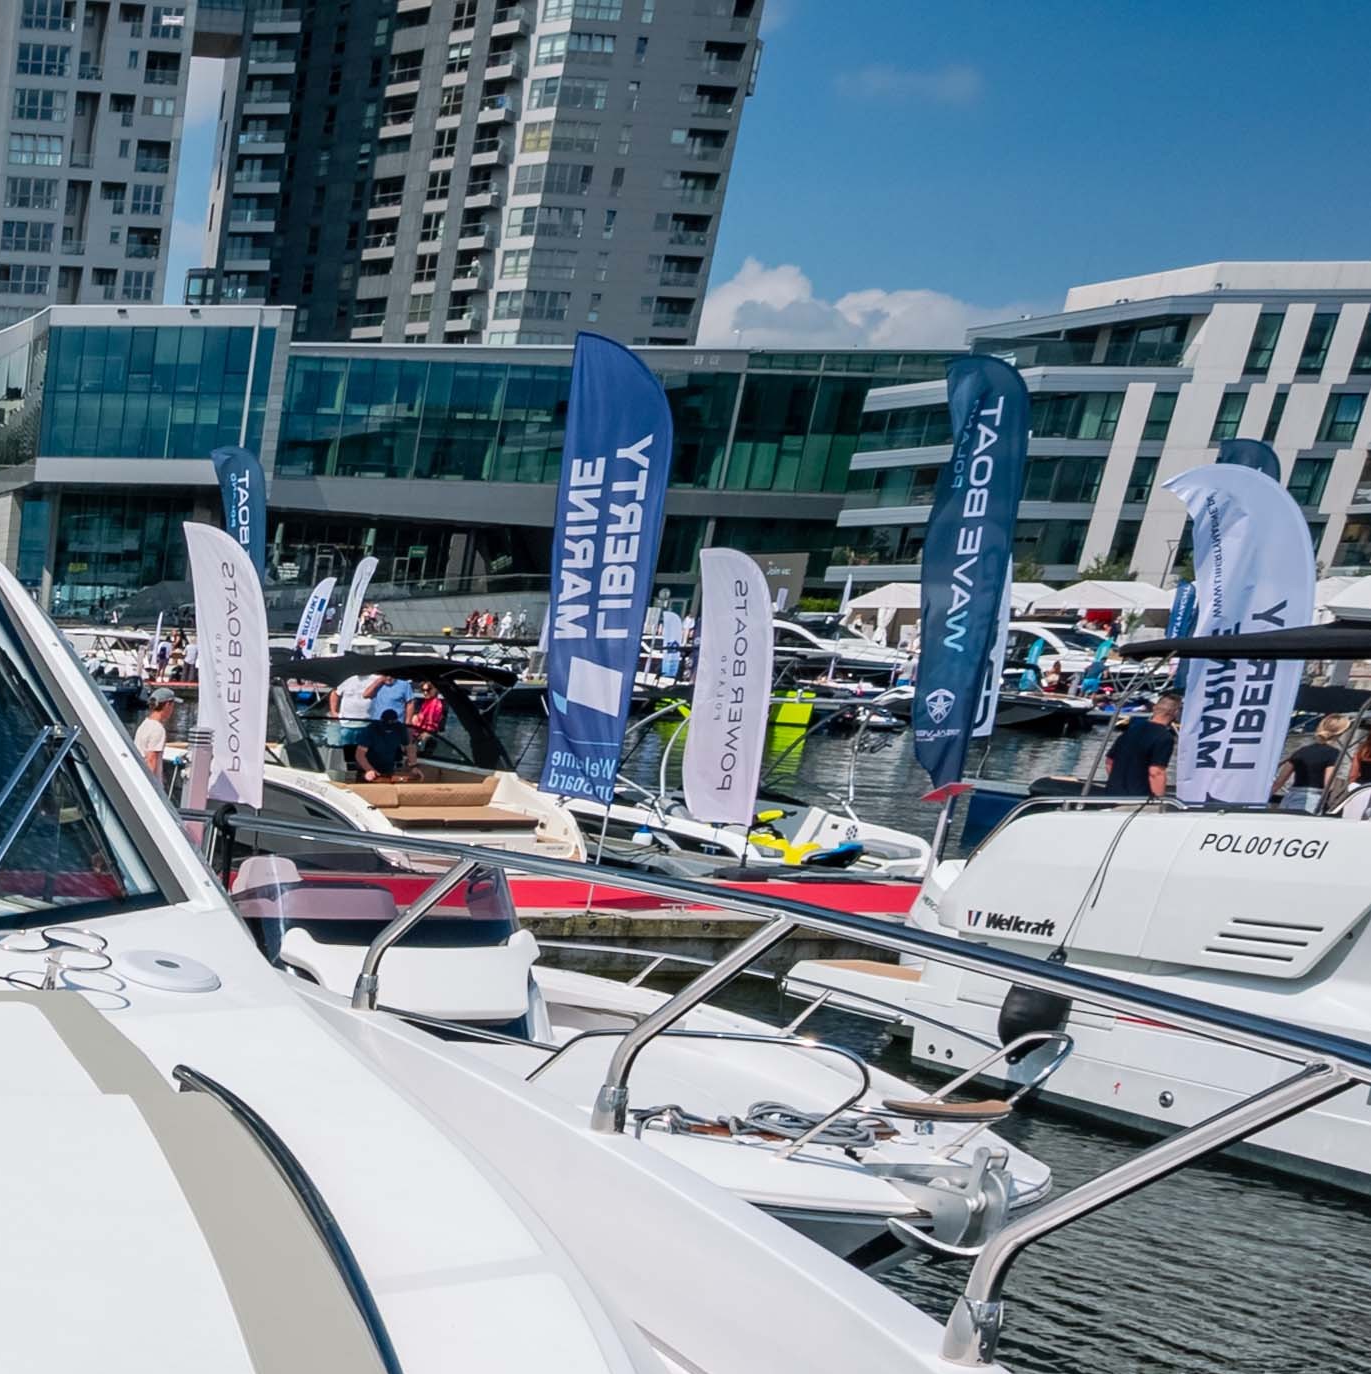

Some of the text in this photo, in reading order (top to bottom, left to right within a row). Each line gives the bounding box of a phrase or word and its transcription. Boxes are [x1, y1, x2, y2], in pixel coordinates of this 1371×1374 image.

[301, 595, 320, 636] SUZUKI
[1200, 832, 1330, 860] POL001GGI
[985, 911, 1057, 937] Wellcraft
